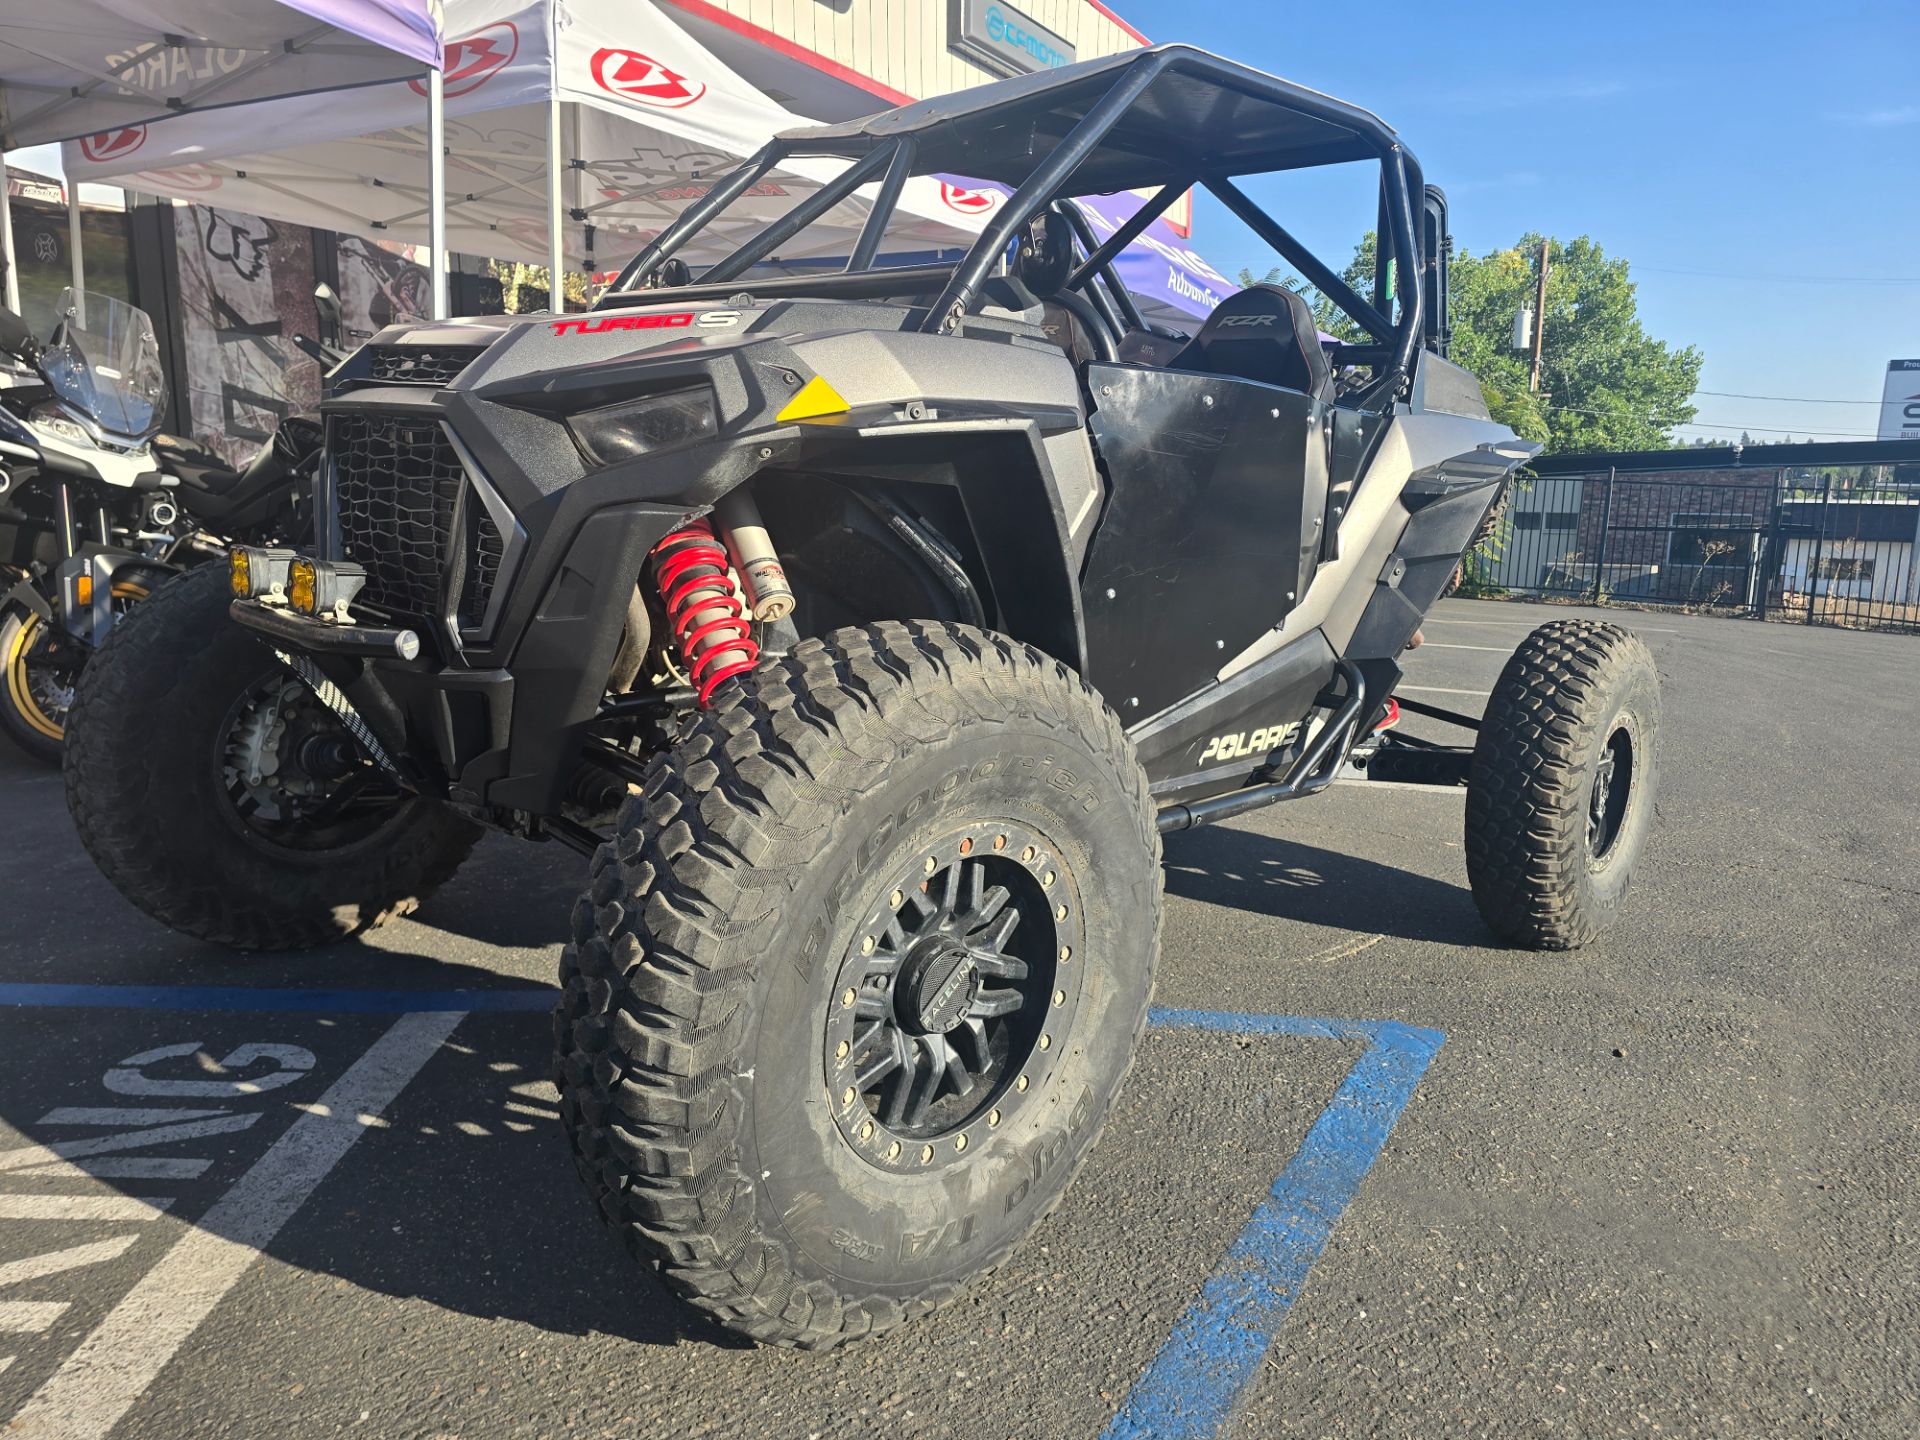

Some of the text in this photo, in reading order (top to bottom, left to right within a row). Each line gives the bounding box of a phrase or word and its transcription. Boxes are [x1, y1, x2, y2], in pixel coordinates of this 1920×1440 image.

[550, 310, 742, 336] TURBO S
[1216, 314, 1278, 329] RZR
[1198, 721, 1302, 767] POLARIS
[923, 956, 976, 1027] RACELINE
